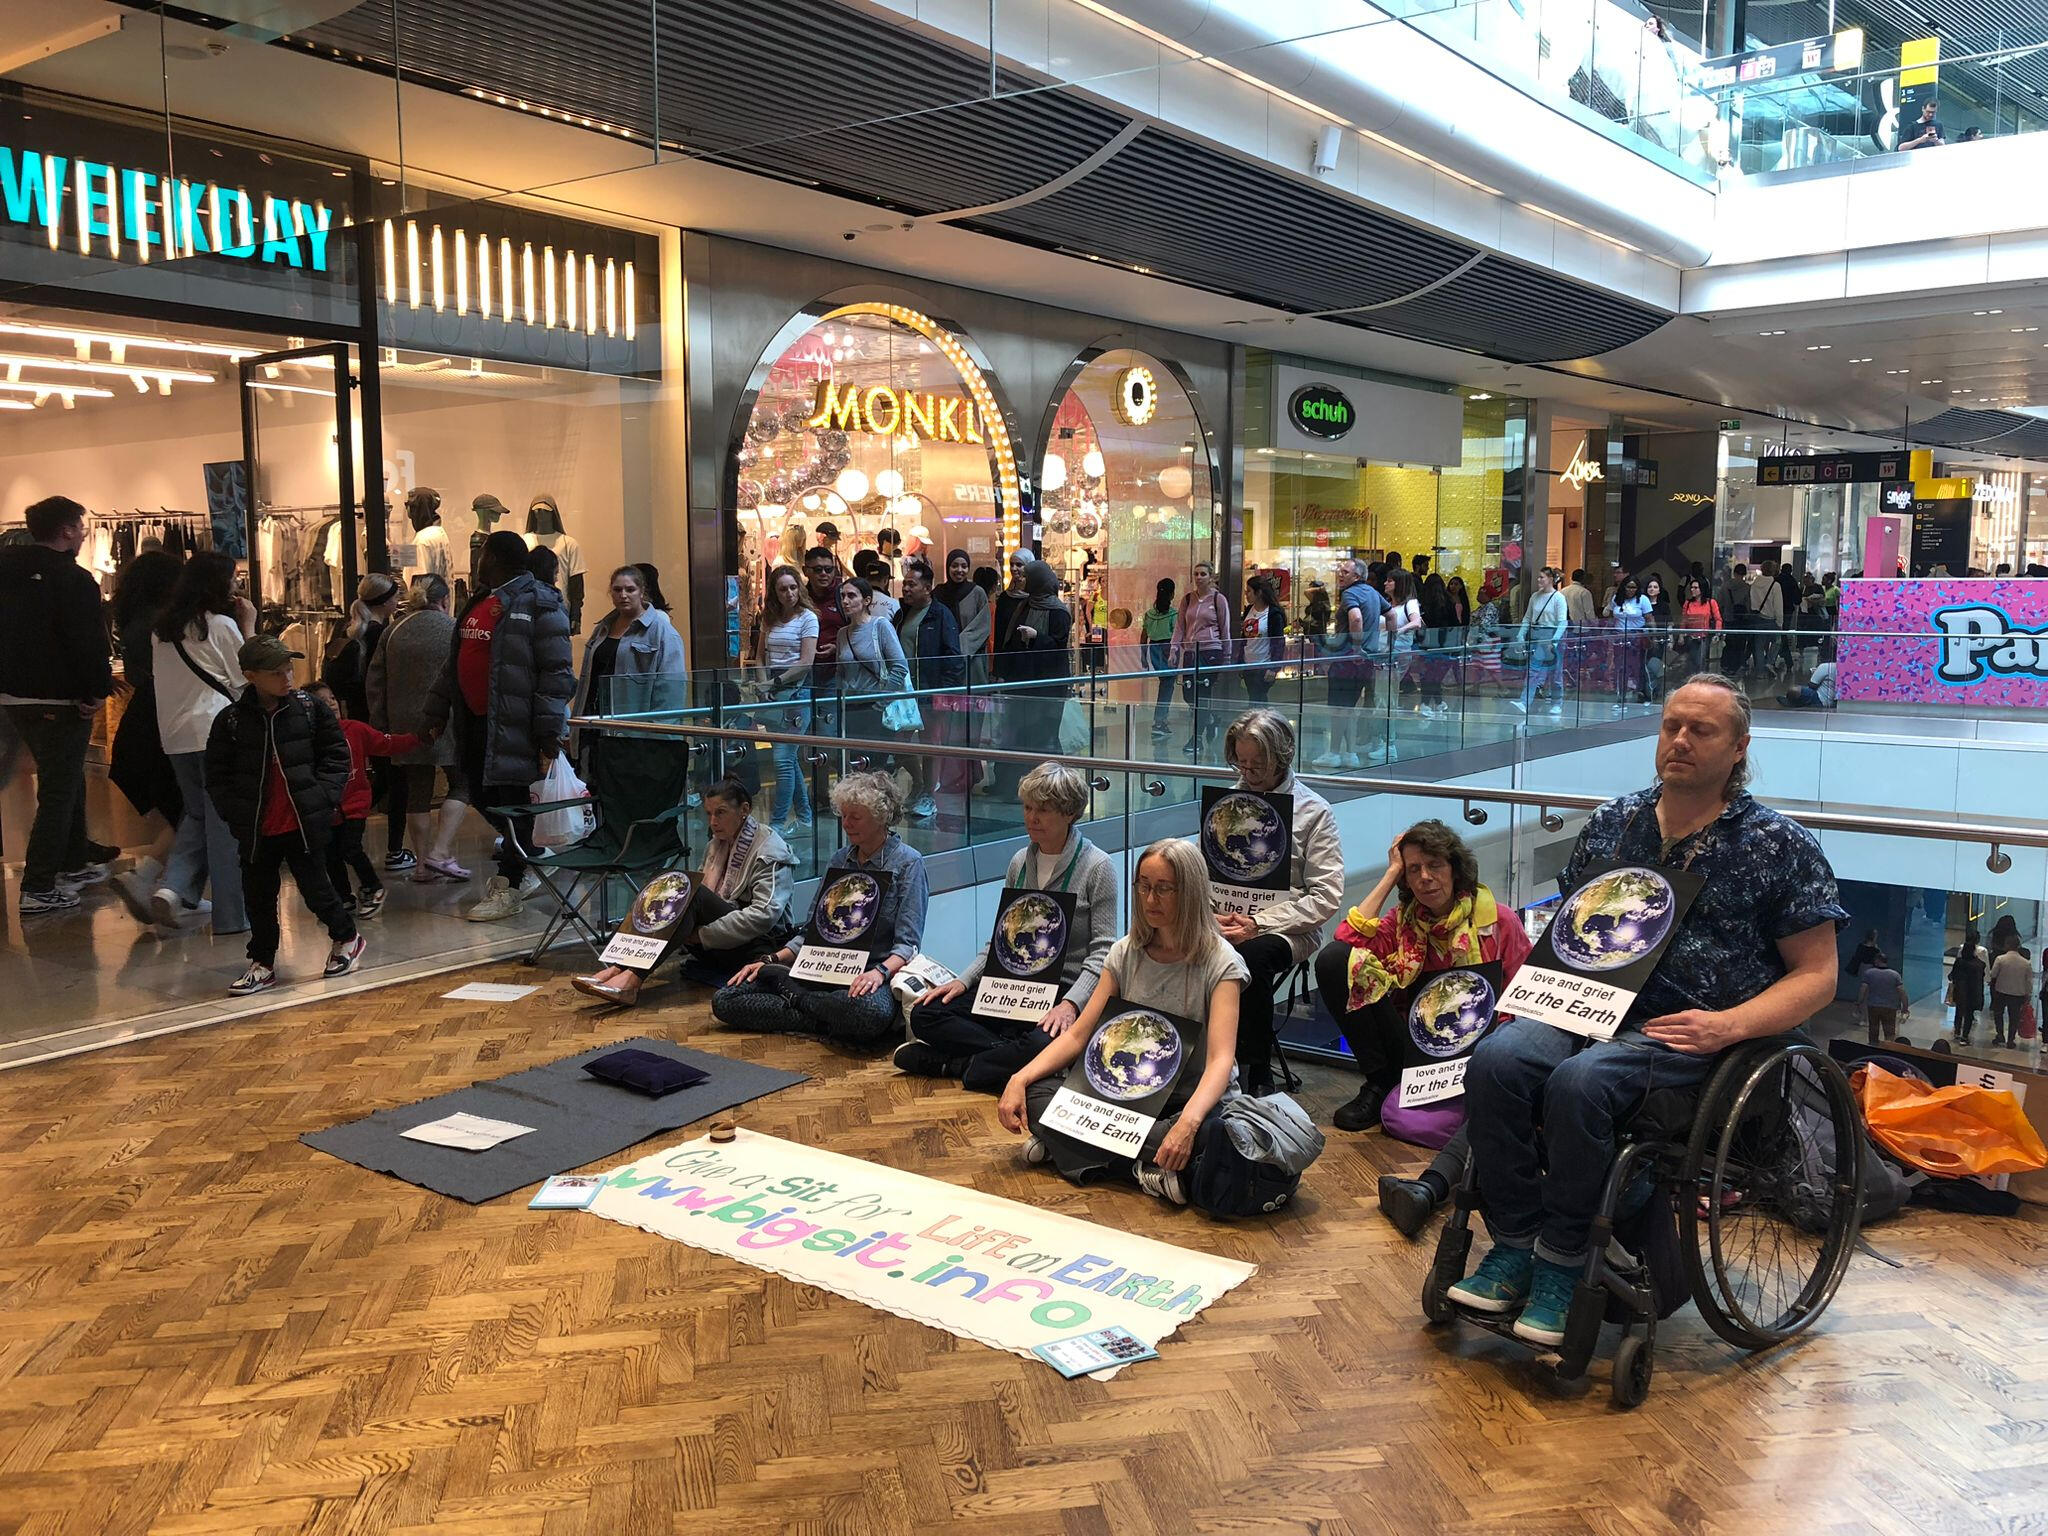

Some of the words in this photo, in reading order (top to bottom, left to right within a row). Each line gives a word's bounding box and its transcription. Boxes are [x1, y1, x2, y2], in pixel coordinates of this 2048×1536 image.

[0, 146, 333, 272] WEEKDAY
[1302, 398, 1348, 424] schuh
[460, 626, 492, 641] mirates
[1935, 605, 2048, 680] Pa
[1212, 885, 1230, 895] love
[1231, 890, 1249, 899] and
[1251, 892, 1276, 902] grief
[1223, 901, 1244, 914] the
[633, 937, 644, 946] and
[644, 940, 660, 948] grief
[607, 944, 621, 953] for
[622, 947, 635, 956] the
[634, 950, 658, 961] Earth
[809, 948, 825, 957] love
[826, 951, 840, 959] and
[840, 952, 859, 961] grief
[798, 959, 815, 969] for
[815, 961, 833, 972] the
[833, 963, 862, 975] Earth
[991, 980, 1009, 990] love
[1009, 984, 1026, 992] and
[1026, 986, 1047, 995] grief
[1531, 971, 1556, 985] love
[1557, 978, 1583, 992] and
[1582, 986, 1616, 1001] grief
[980, 992, 997, 1004] for
[999, 995, 1018, 1007] the
[1020, 997, 1051, 1011] Earth
[1508, 985, 1536, 1001] for
[1535, 992, 1564, 1010] the
[1565, 999, 1618, 1026] Earth
[1415, 1068, 1436, 1078] love
[1438, 1062, 1456, 1074] and
[1405, 1083, 1426, 1096] for
[1428, 1079, 1449, 1092] the
[1069, 1095, 1093, 1110] love
[1093, 1105, 1115, 1117] and
[1114, 1110, 1140, 1125] grief
[1052, 1104, 1076, 1120] for
[1075, 1114, 1100, 1131] the
[1101, 1123, 1142, 1145] Earth
[665, 1150, 737, 1179] Give
[729, 1174, 774, 1190] a
[806, 1193, 913, 1220] for
[1006, 1252, 1062, 1273] on
